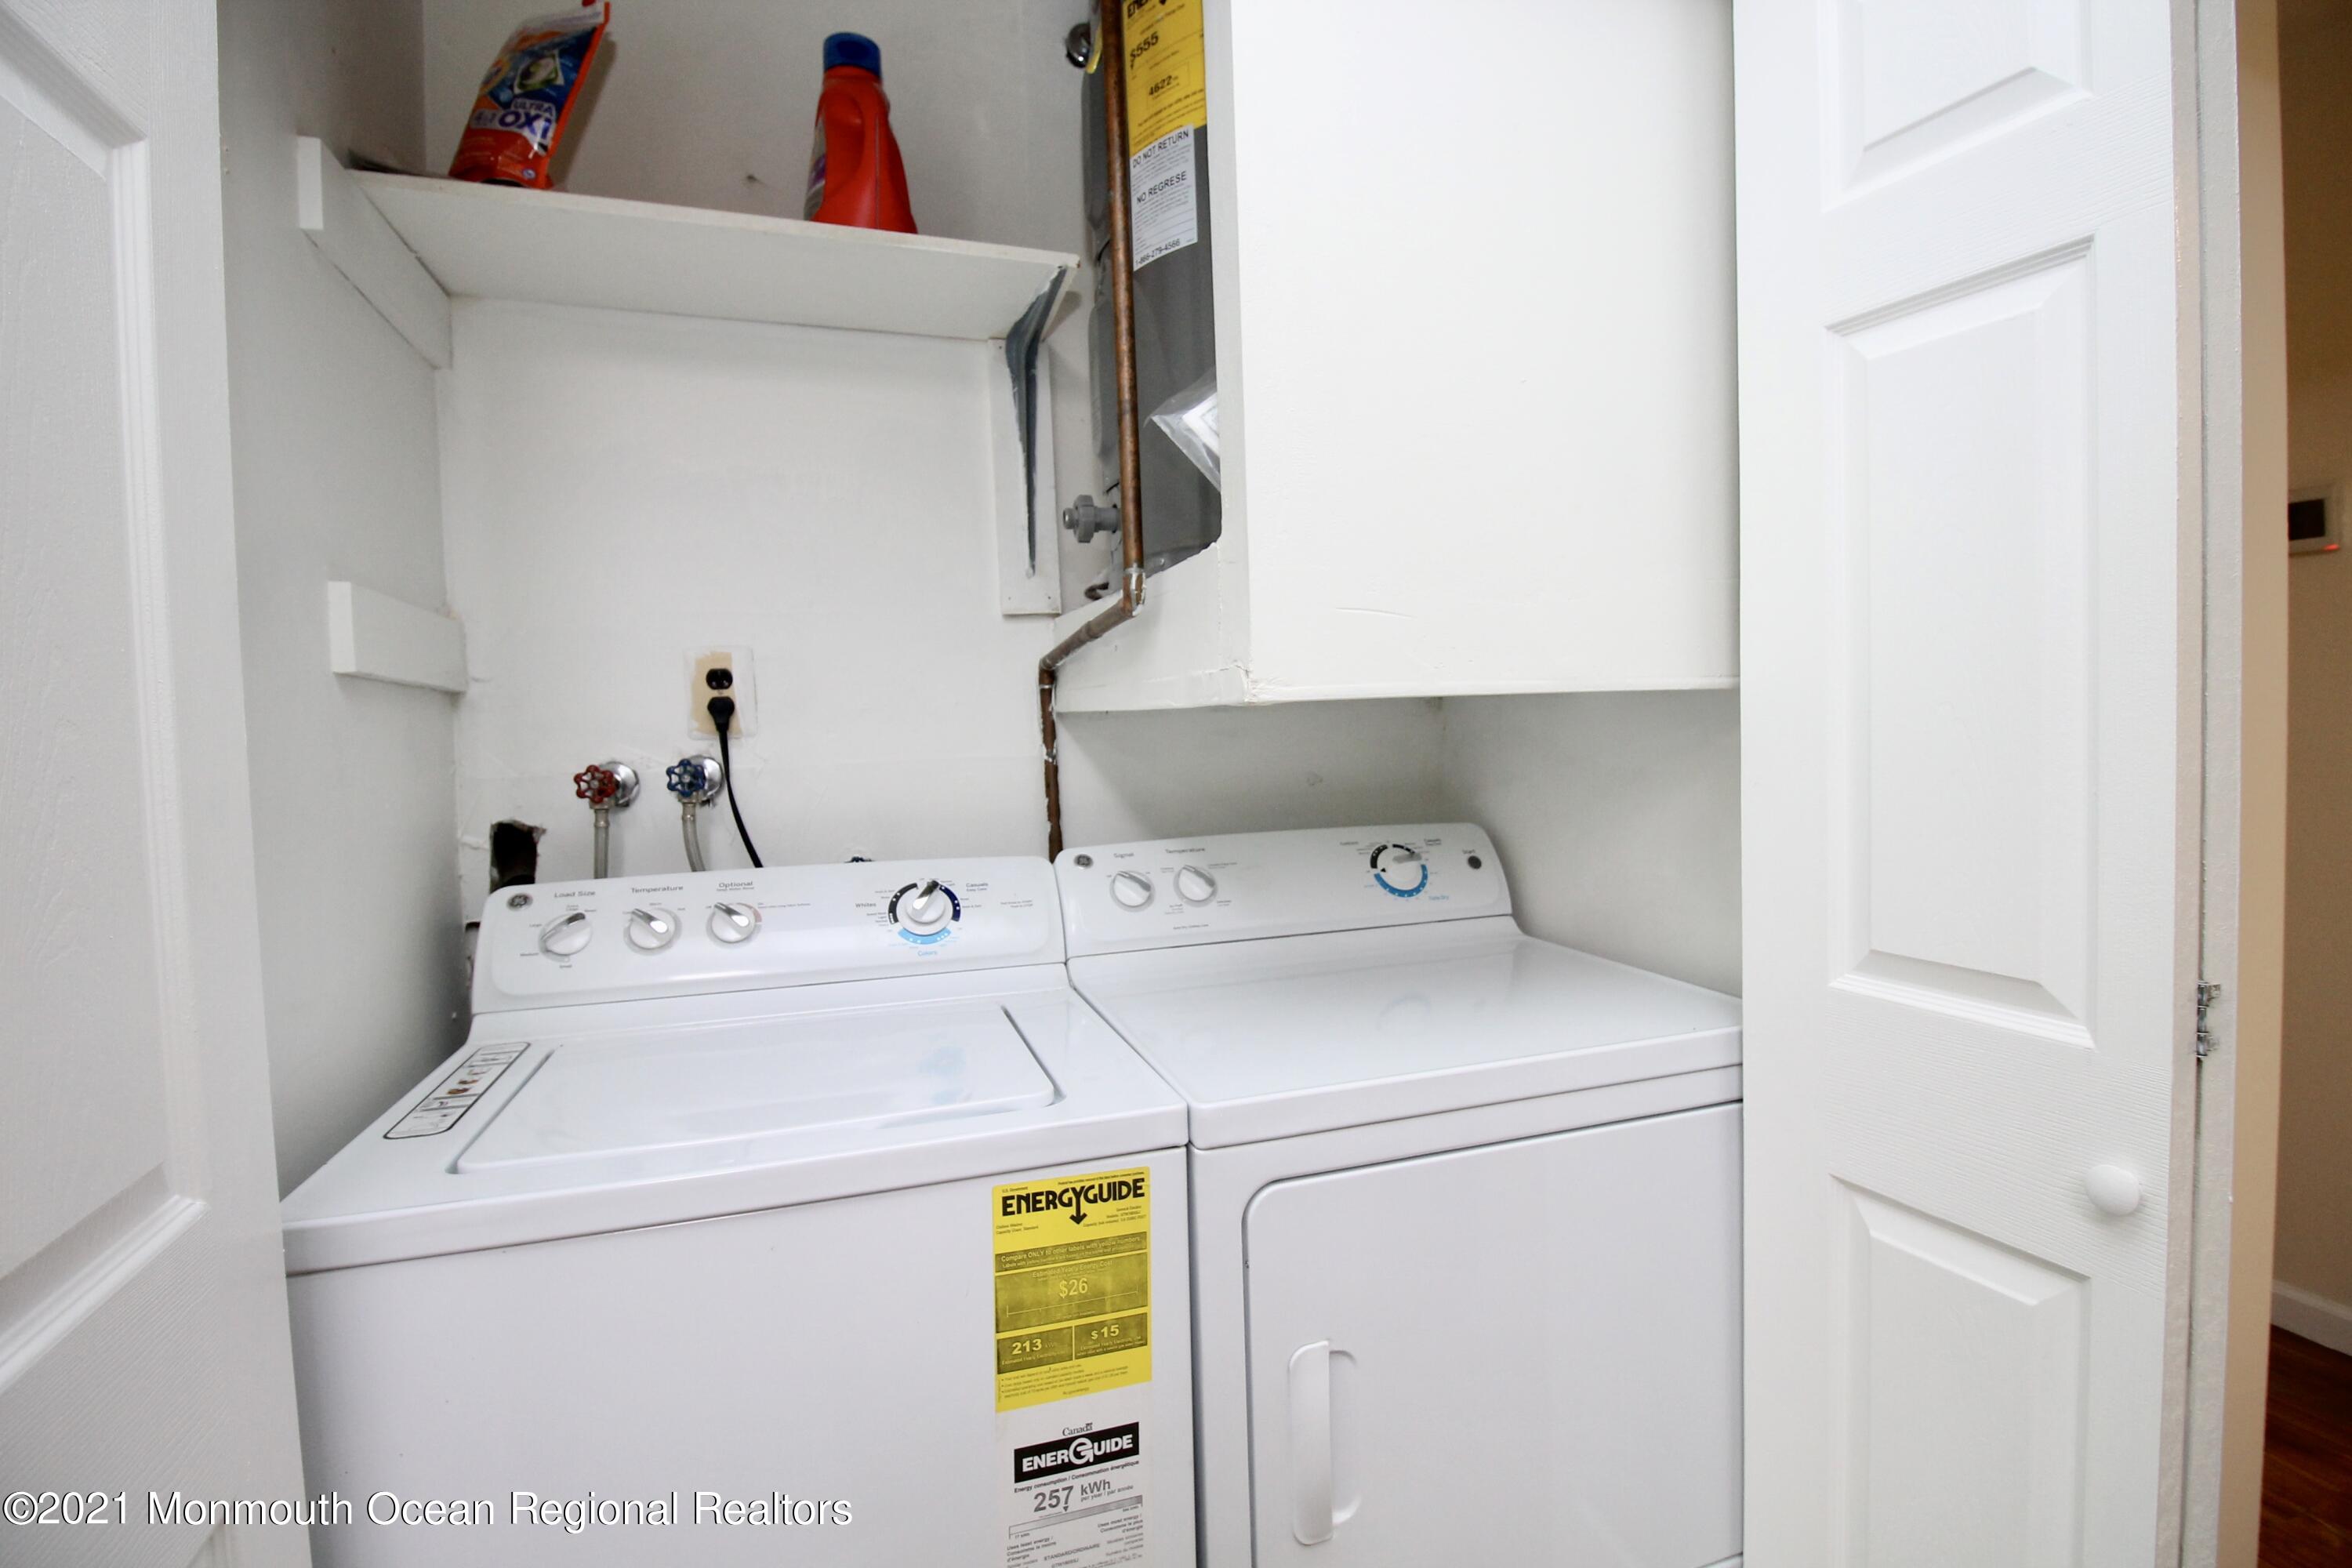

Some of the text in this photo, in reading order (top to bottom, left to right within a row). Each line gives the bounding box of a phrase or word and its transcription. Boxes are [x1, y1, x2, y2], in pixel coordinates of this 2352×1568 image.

[514, 100, 554, 116] ULTRA
[499, 111, 553, 140] OXI
[1132, 129, 1189, 169] DO NOT RETURN
[1137, 170, 1187, 203] NO REGRESE
[631, 885, 684, 894] Temperature
[1002, 1178, 1145, 1218] ENERGYGUIDE
[1001, 1254, 1026, 1262] Compare
[1028, 1250, 1044, 1258] ONLY
[1069, 1243, 1084, 1252] labels
[1059, 1277, 1088, 1298] $26
[1011, 1338, 1042, 1355] 213
[1062, 1423, 1093, 1436] Canada
[1022, 1434, 1133, 1472] ENERGUIDE
[1033, 1477, 1067, 1488] consumption
[1071, 1467, 1109, 1480] Consommation
[1033, 1479, 1111, 1512] 257 kWh
